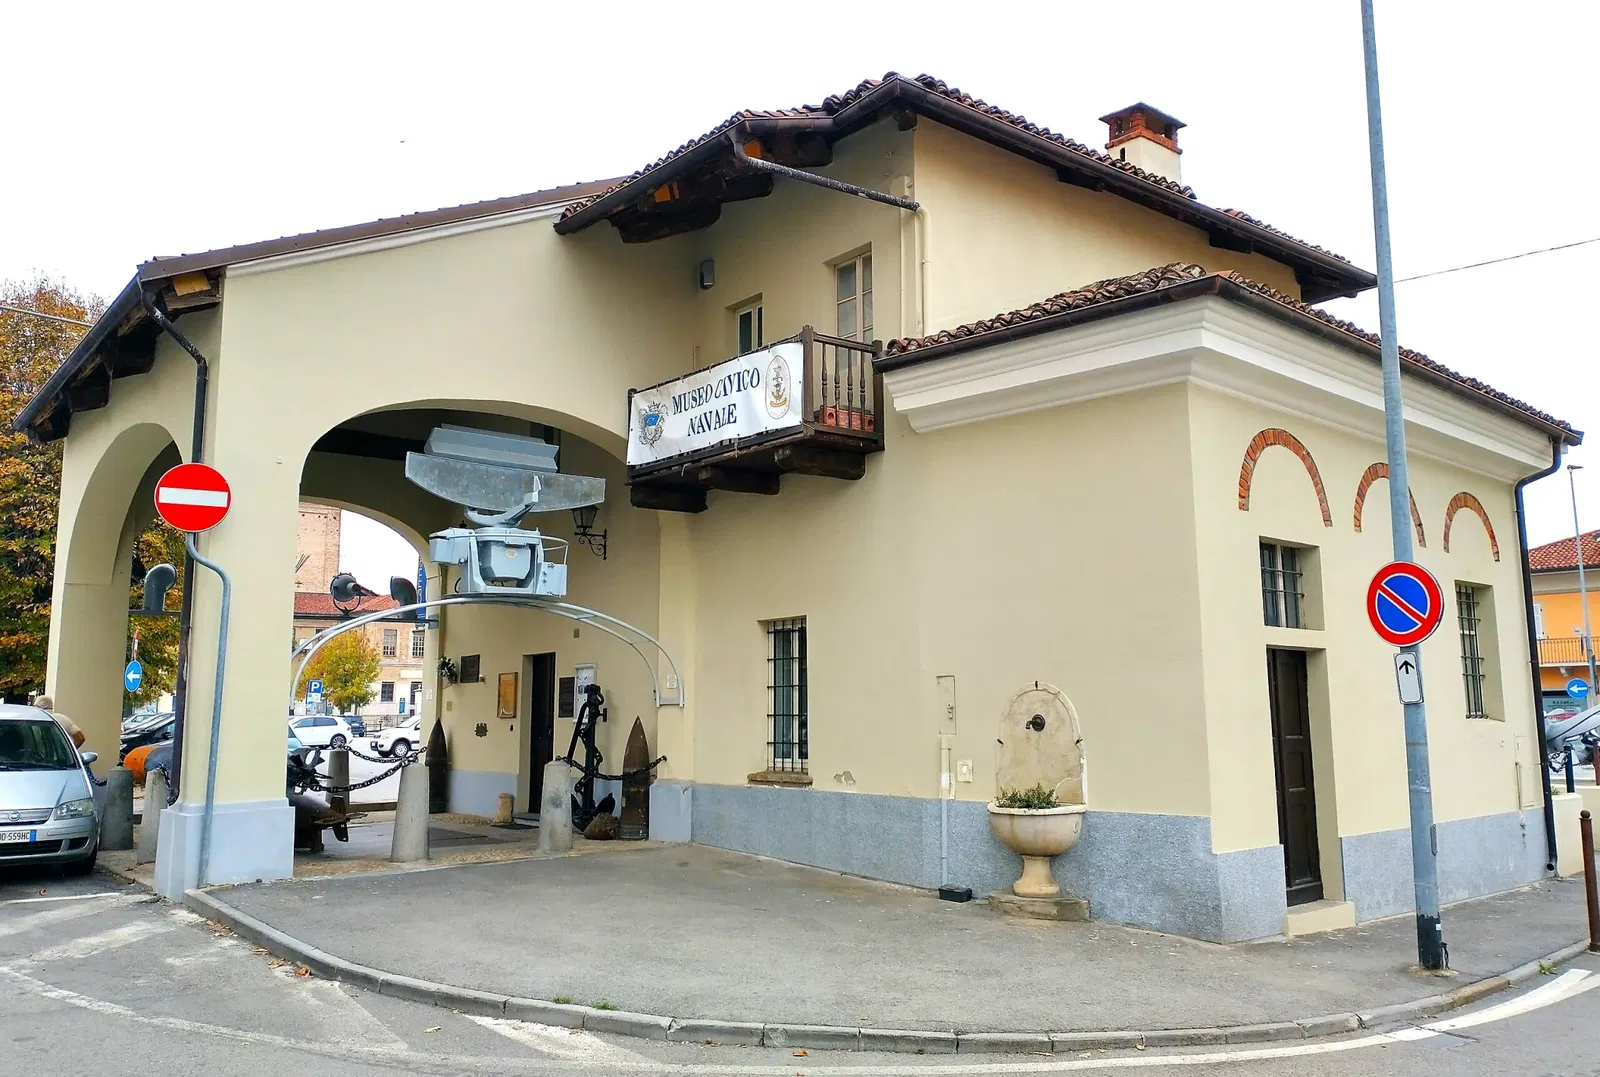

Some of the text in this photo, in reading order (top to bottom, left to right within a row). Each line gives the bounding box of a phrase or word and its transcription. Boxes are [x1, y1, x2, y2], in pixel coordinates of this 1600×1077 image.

[671, 367, 760, 415] MUSEO CIVICO
[687, 403, 737, 437] NAVALE
[311, 681, 320, 692] P
